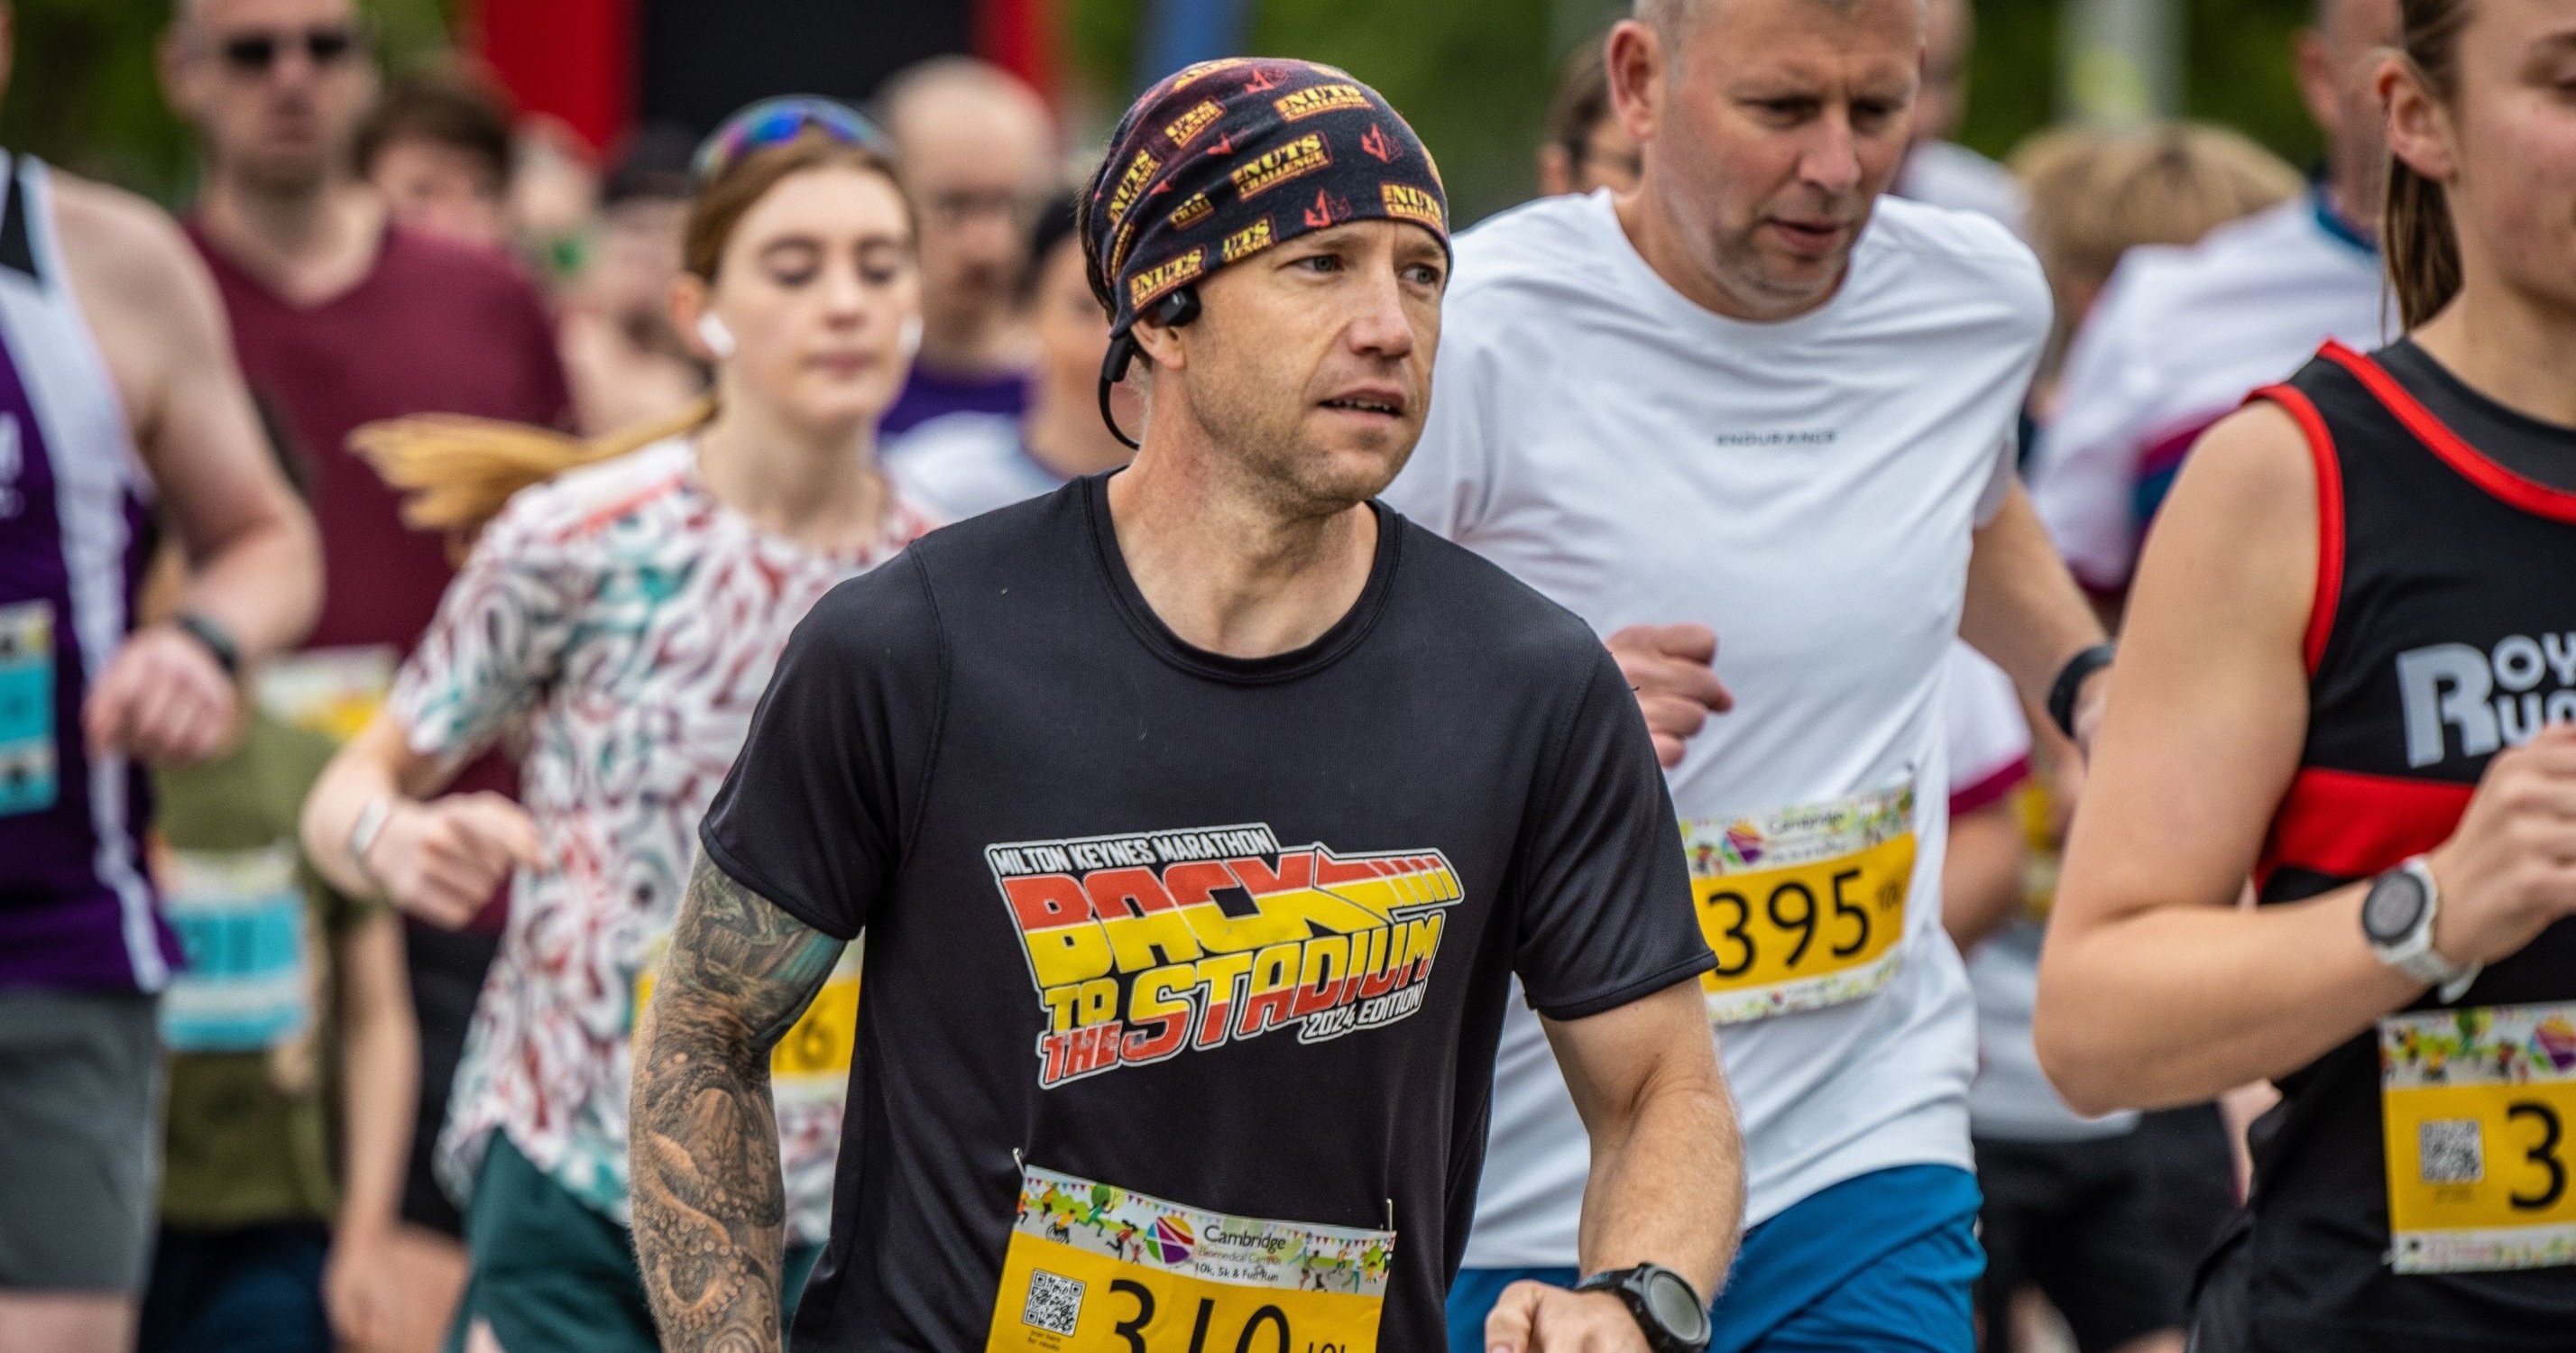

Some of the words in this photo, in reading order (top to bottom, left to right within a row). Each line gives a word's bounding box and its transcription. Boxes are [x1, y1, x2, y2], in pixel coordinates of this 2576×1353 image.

[1284, 85, 1361, 108] NUTS
[1239, 150, 1325, 193] CHALLENGE
[1244, 134, 1321, 177] NUTS
[990, 844, 1072, 876] MILTON
[1067, 838, 1156, 870] KEYNES
[1151, 829, 1275, 862] MARATHON
[1001, 851, 1389, 989] BACK
[1707, 868, 1872, 979] 395
[1044, 977, 1118, 1035] TO
[1119, 912, 1443, 1062] STADIUM
[1304, 1003, 1357, 1038] 2024
[1357, 980, 1424, 1024] EDITION
[1042, 1020, 1123, 1083] THE
[1203, 1224, 1287, 1255] Cambridge
[1219, 1266, 1231, 1278] 5k
[1232, 1268, 1240, 1279] &
